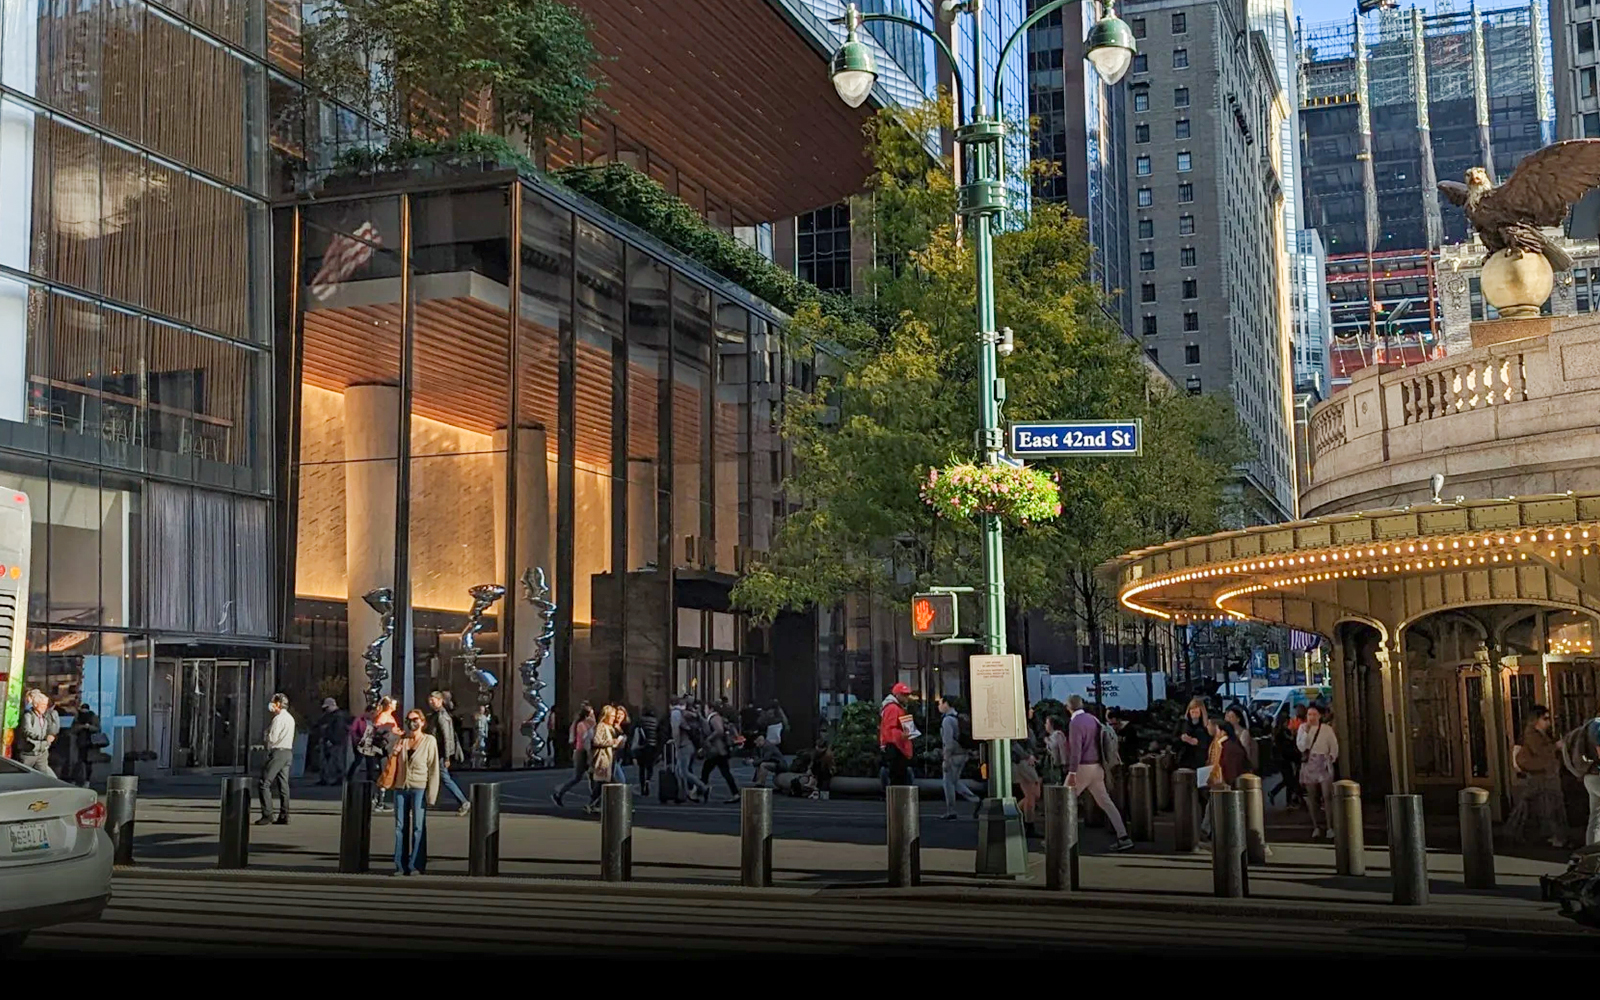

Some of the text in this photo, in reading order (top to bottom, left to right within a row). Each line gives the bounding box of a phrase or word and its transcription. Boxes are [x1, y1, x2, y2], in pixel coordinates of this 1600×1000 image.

[1019, 430, 1131, 447] East 42nd St
